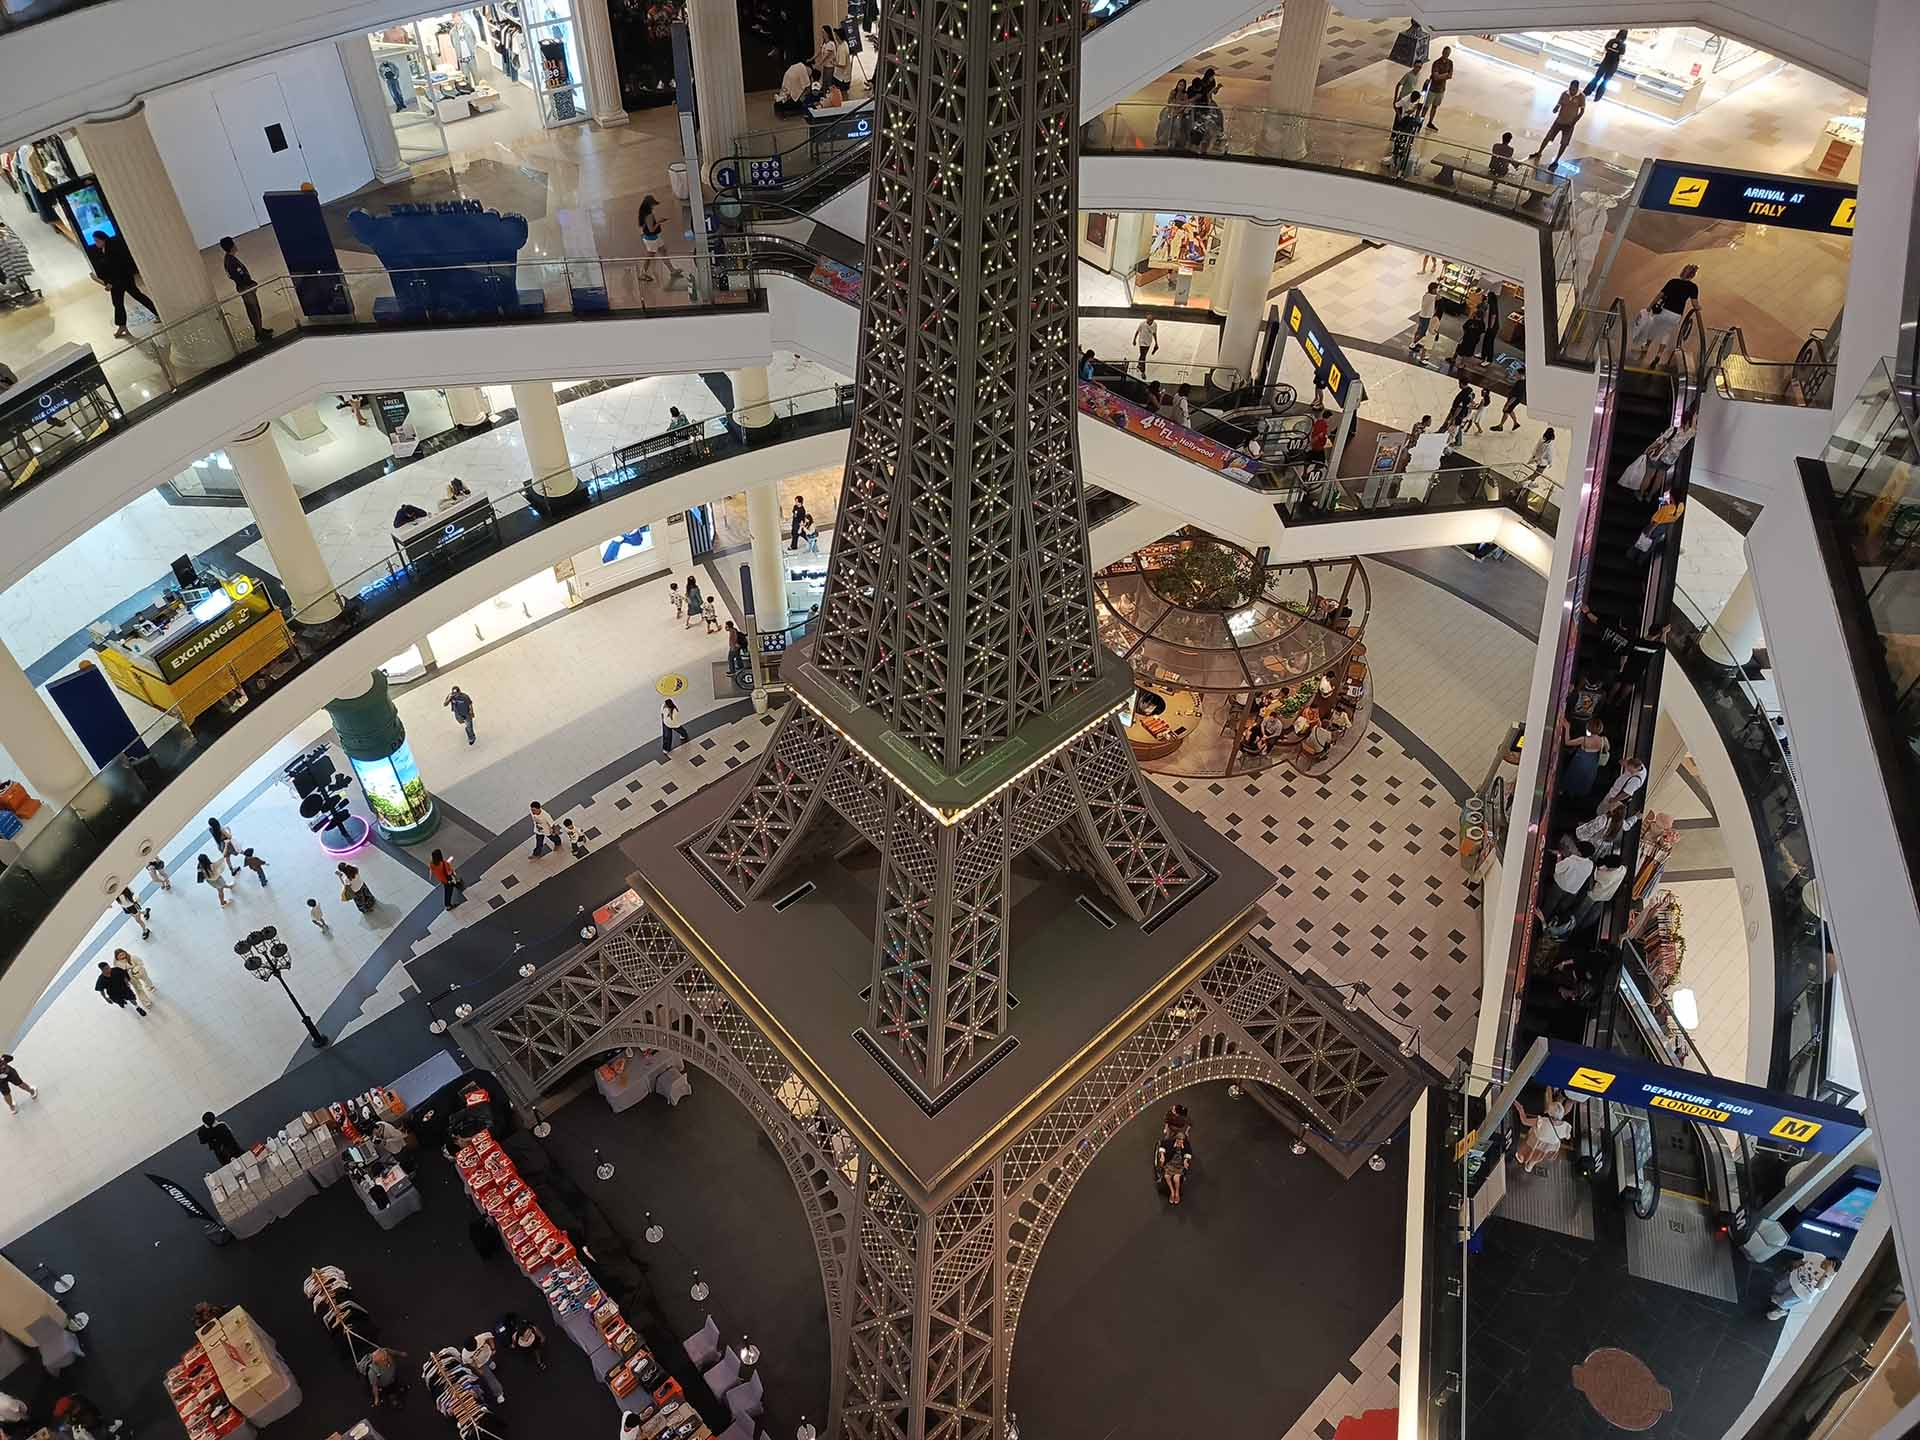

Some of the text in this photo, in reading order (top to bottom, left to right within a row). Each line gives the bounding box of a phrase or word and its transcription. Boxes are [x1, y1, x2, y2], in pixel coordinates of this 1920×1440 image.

[1744, 187, 1805, 204] ARRIVAL AT
[1749, 202, 1787, 217] ITALY
[1278, 394, 1289, 404] M
[1140, 415, 1167, 429] 4th
[1179, 437, 1215, 458] Hollywood
[171, 619, 236, 669] EXCHANGE
[744, 674, 753, 683] G
[1641, 1083, 1754, 1116] DEPARTURE FROM
[1657, 1098, 1722, 1119] LONDON
[1779, 1120, 1811, 1137] M
